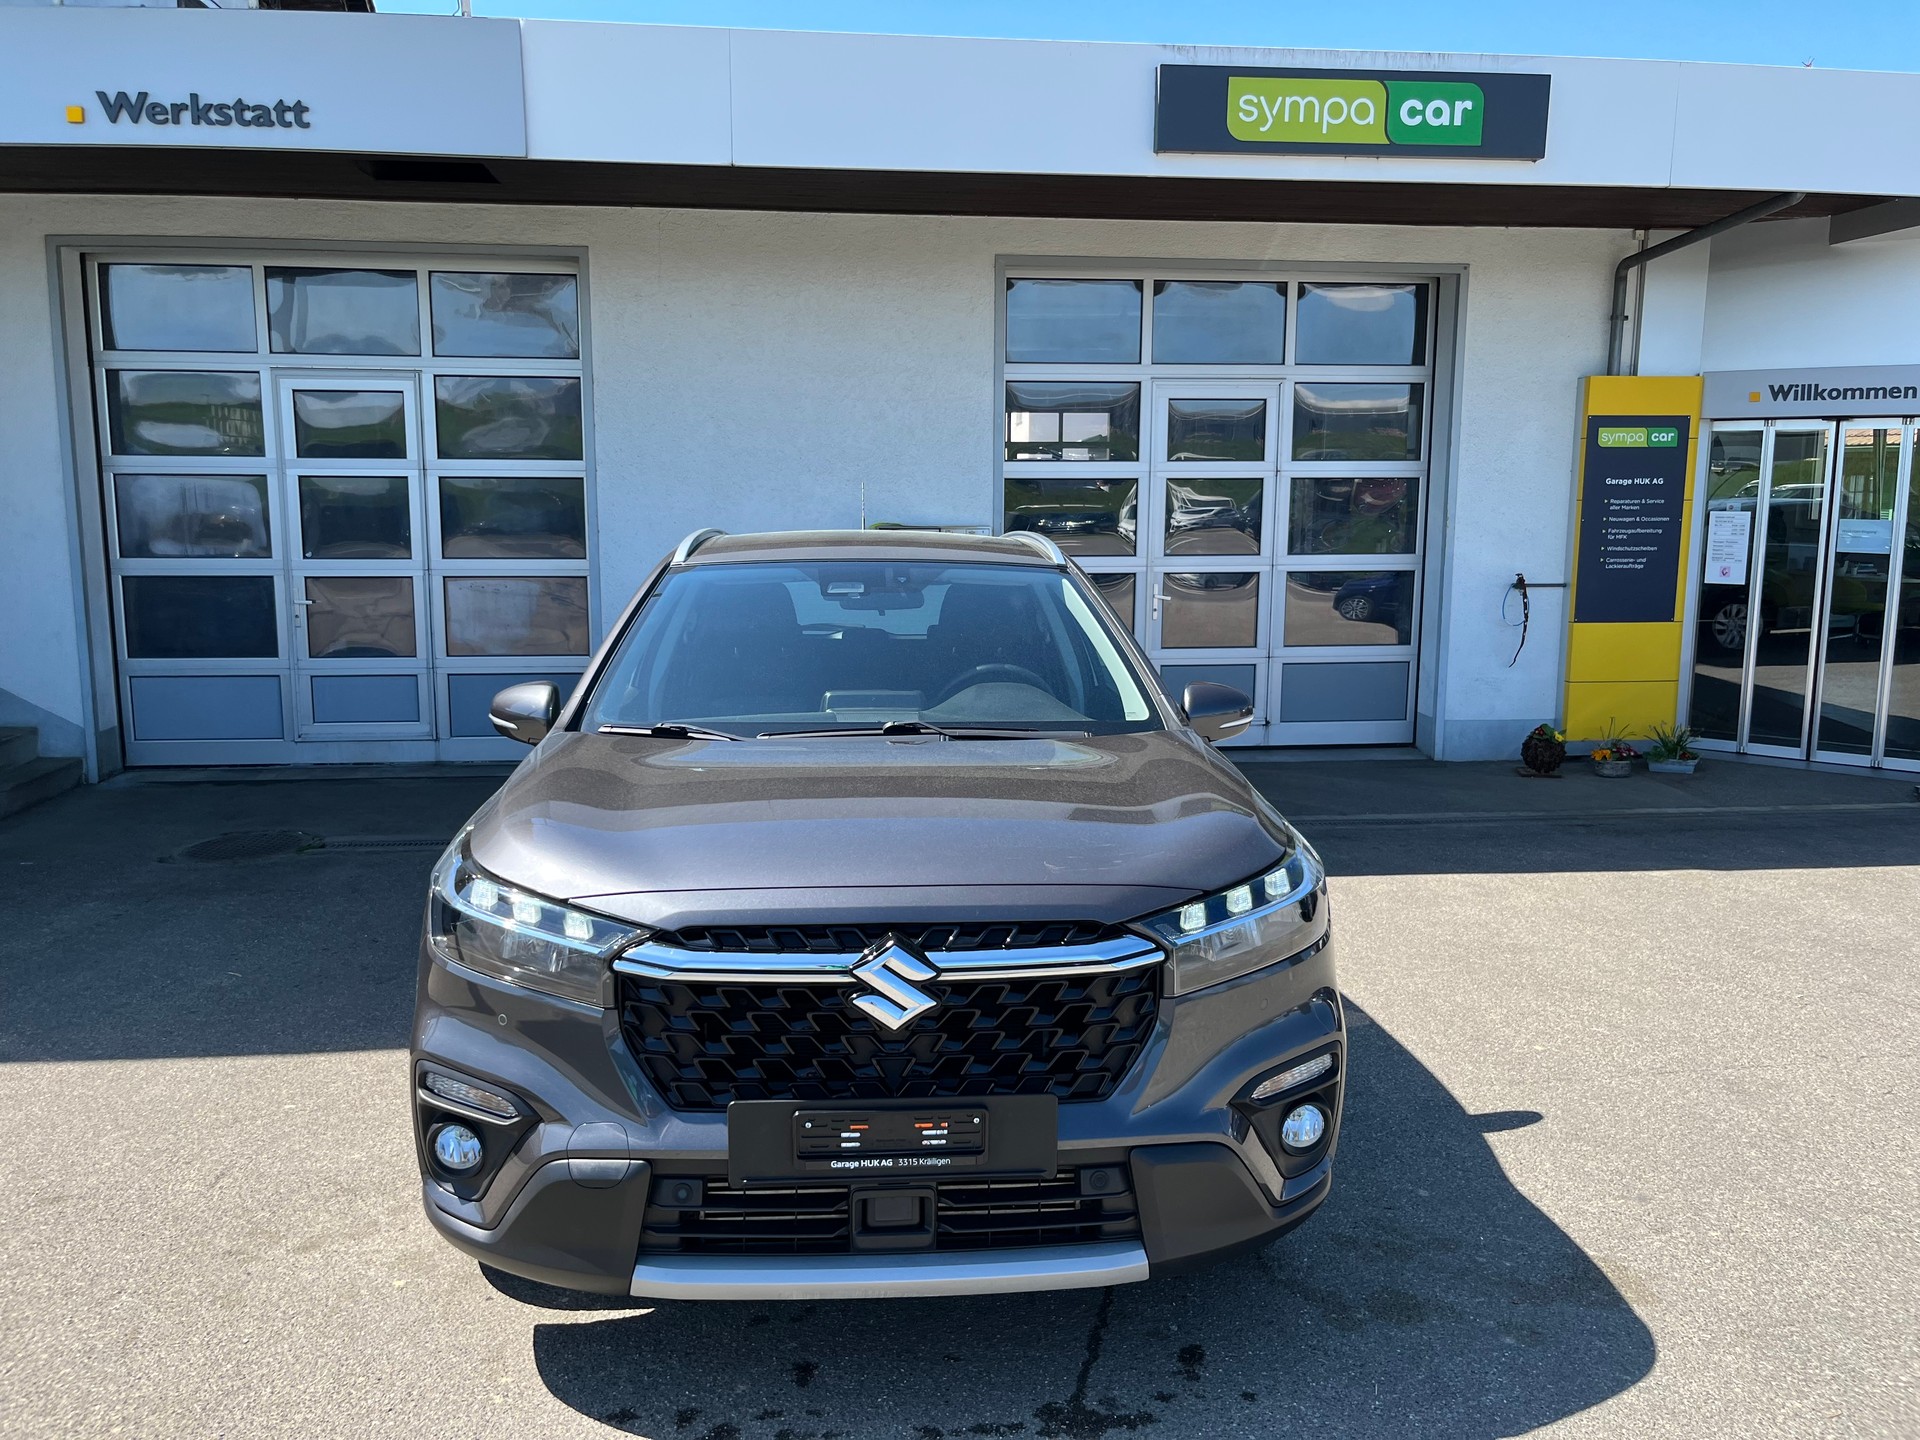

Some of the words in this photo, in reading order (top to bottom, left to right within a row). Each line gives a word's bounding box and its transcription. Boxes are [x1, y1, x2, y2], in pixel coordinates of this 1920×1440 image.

[95, 91, 311, 128] Werkstatt
[1238, 94, 1375, 134] sympa
[1399, 98, 1473, 127] car
[1768, 383, 1918, 402] Willkommen
[1601, 432, 1645, 445] sympa
[1651, 432, 1675, 442] car
[1605, 477, 1633, 486] Garage
[1634, 477, 1651, 485] HUK
[1652, 477, 1664, 485] AG
[830, 1160, 860, 1169] Garage
[860, 1159, 880, 1168] HUK
[881, 1158, 893, 1167] AG
[898, 1158, 918, 1166] 3315
